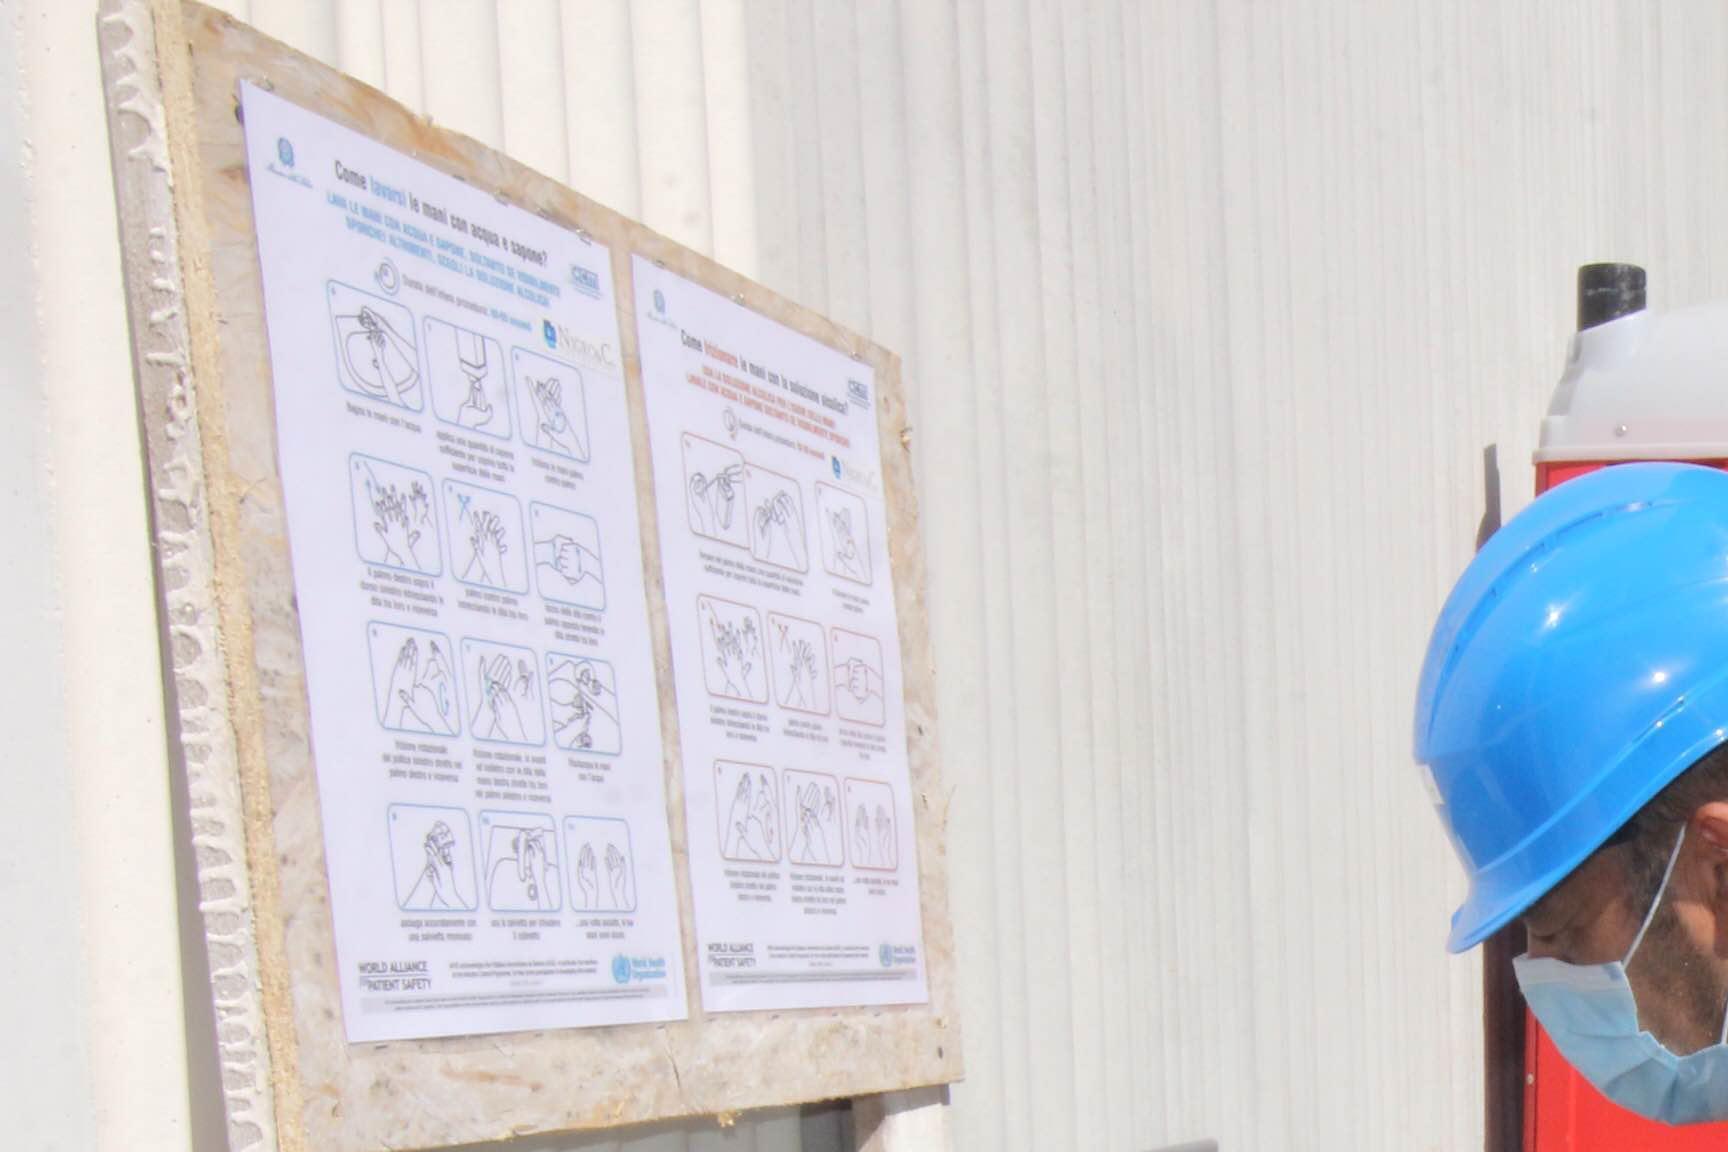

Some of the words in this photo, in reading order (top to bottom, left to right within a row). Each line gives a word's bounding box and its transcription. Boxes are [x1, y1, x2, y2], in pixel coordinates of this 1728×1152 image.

[335, 159, 367, 190] Come
[409, 191, 420, 213] le
[422, 201, 448, 225] mani
[450, 214, 468, 233] con
[471, 223, 500, 248] acqua
[681, 329, 703, 352] Come
[749, 362, 766, 380] mani
[767, 370, 780, 386] con
[358, 961, 388, 974] WORLD
[390, 960, 429, 973] ALLIANCE
[367, 979, 400, 991] PATIENT
[402, 978, 432, 990] SAFETY
